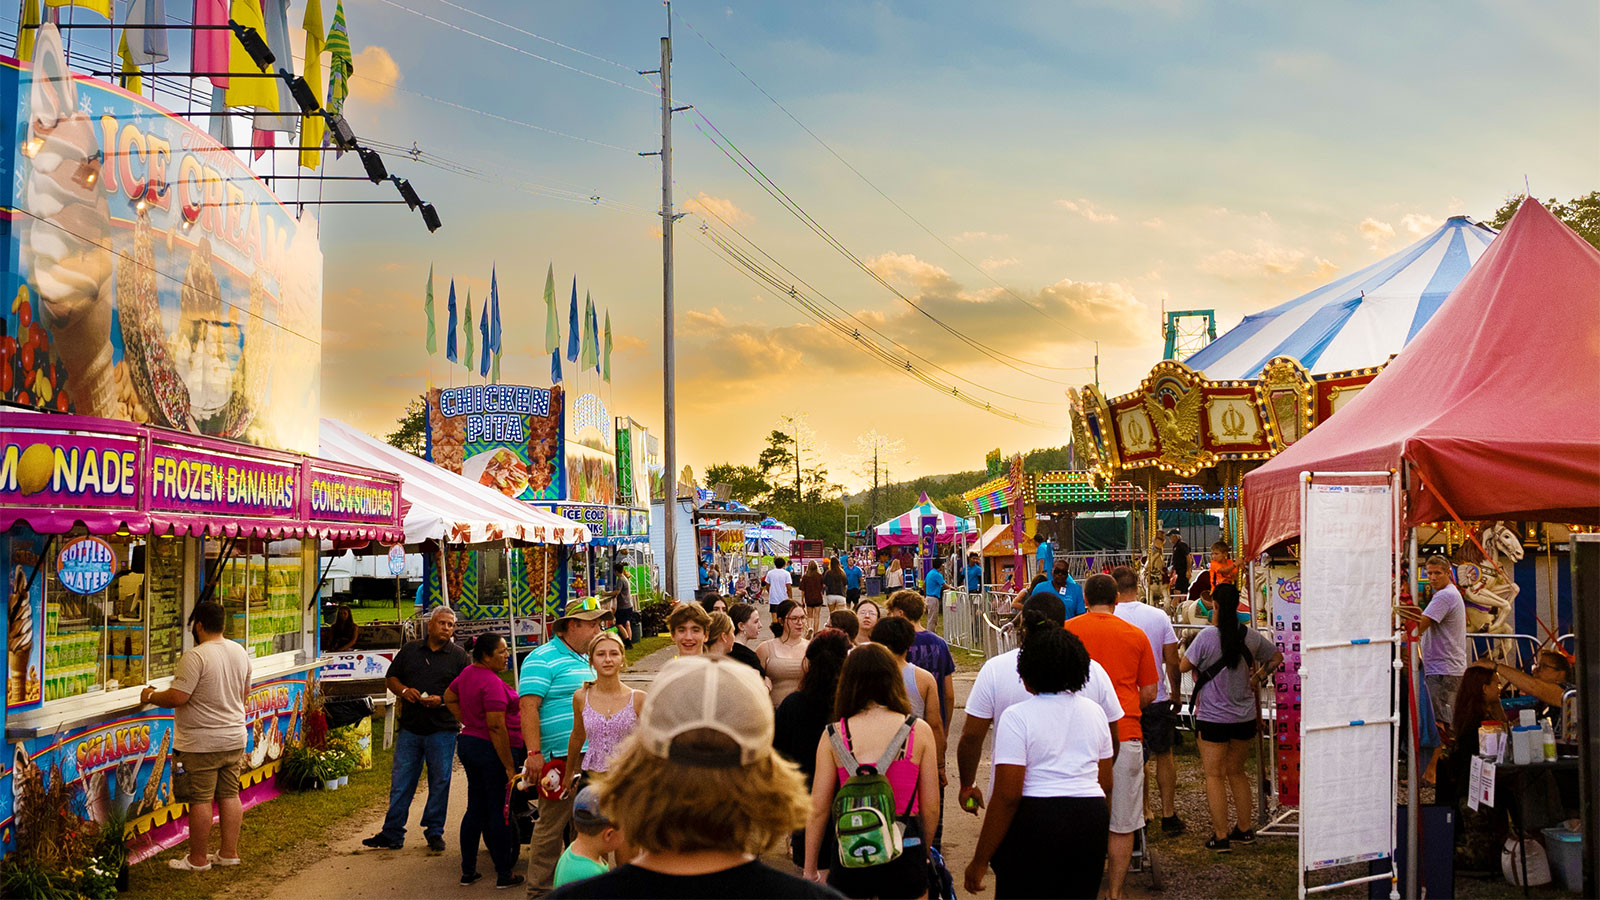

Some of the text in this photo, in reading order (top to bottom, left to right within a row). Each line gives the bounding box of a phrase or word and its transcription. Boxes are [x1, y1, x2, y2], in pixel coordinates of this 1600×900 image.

[100, 114, 171, 212] ICE
[178, 154, 288, 284] CREAM
[440, 384, 551, 417] CHICKEN
[467, 414, 524, 442] PITA
[152, 455, 294, 509] FROZEN BANANAS
[311, 478, 346, 512] CONES
[562, 508, 605, 521] ICE COLD
[61, 540, 112, 562] BOTTLED
[64, 571, 109, 591] WATER
[339, 654, 355, 662] TO
[76, 724, 151, 771] SHAKES
